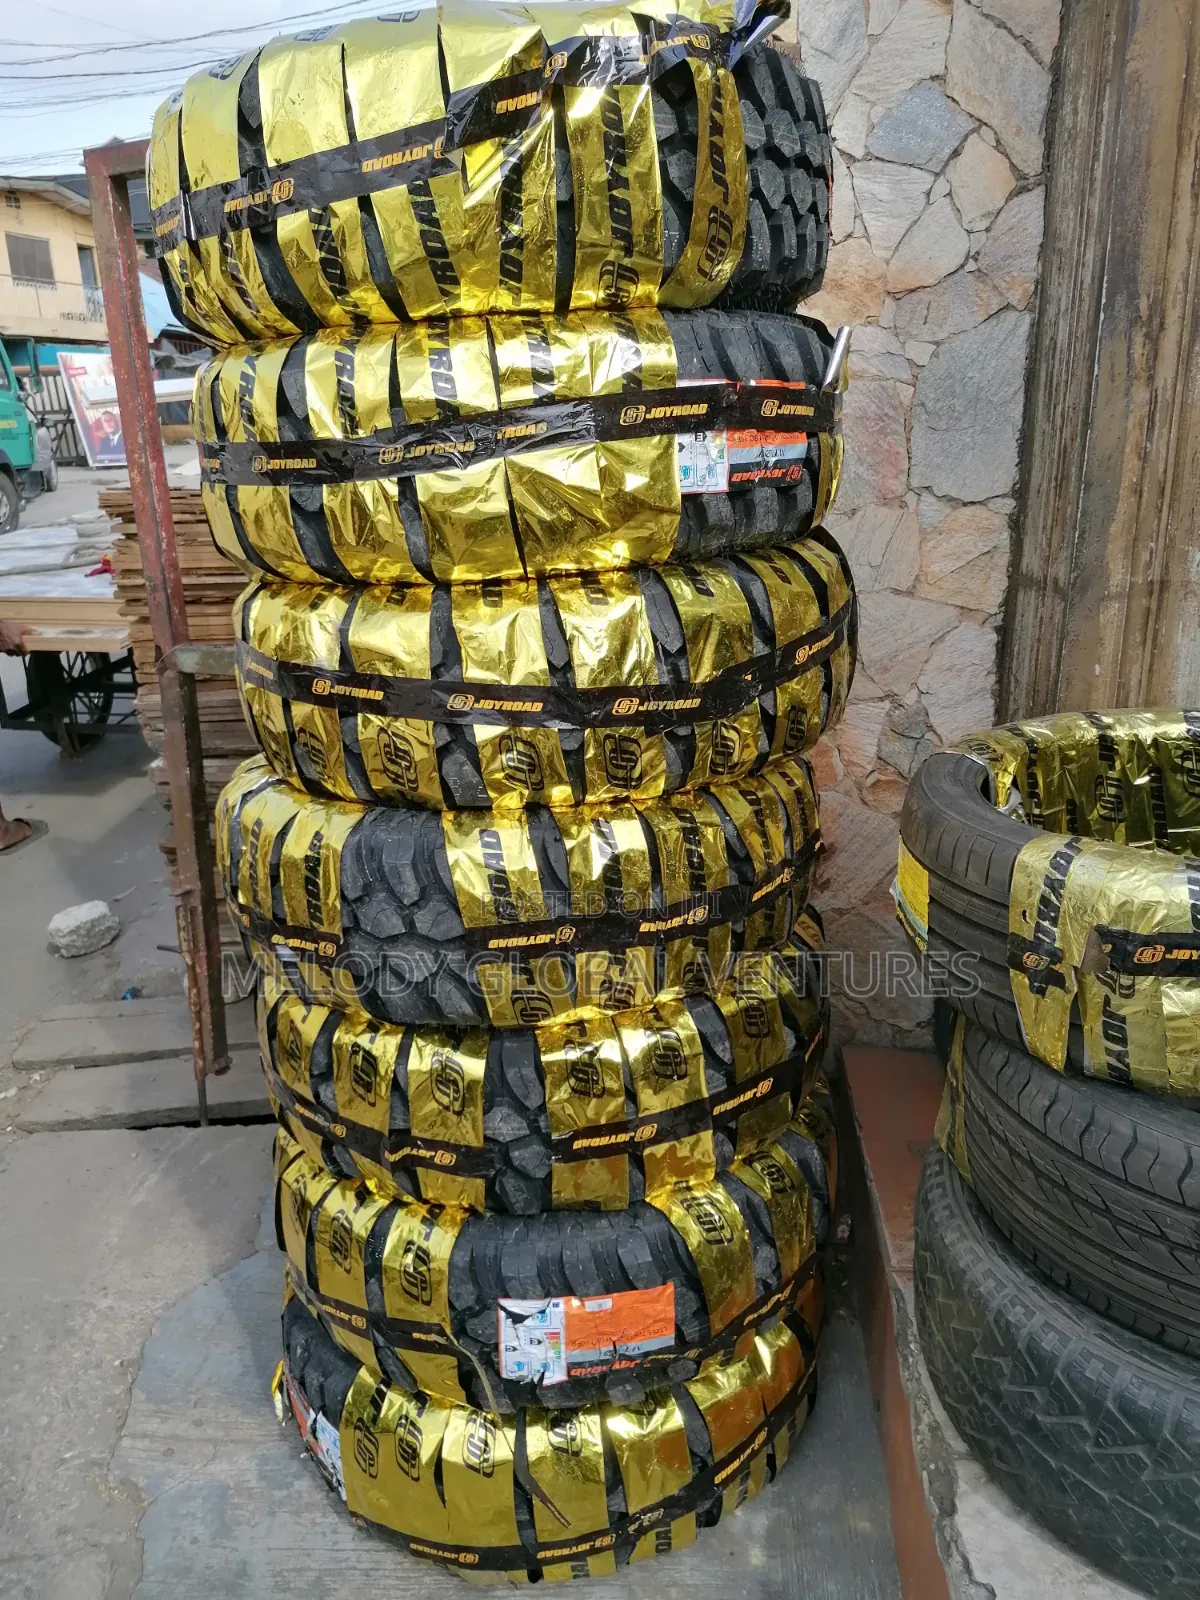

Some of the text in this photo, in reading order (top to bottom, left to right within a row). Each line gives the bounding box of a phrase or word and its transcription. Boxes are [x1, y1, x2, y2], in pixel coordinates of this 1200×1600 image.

[362, 144, 435, 173] JOYROAD
[645, 403, 708, 419] JOYROAD
[404, 441, 476, 458] JOYROAD
[267, 458, 317, 470] JOYROAD
[731, 468, 786, 483] JOYROAD
[331, 685, 384, 701] JOYROAD
[474, 699, 543, 712] JOYROAD
[638, 698, 701, 711] JOYROAD
[488, 932, 556, 949] JOYROAD
[713, 1094, 758, 1116] JOYROAD
[573, 1131, 635, 1149] JOYROAD
[714, 1446, 756, 1485] JOYROAD
[410, 1543, 458, 1558] JOYROAD
[537, 1542, 595, 1560] JOYROAD
